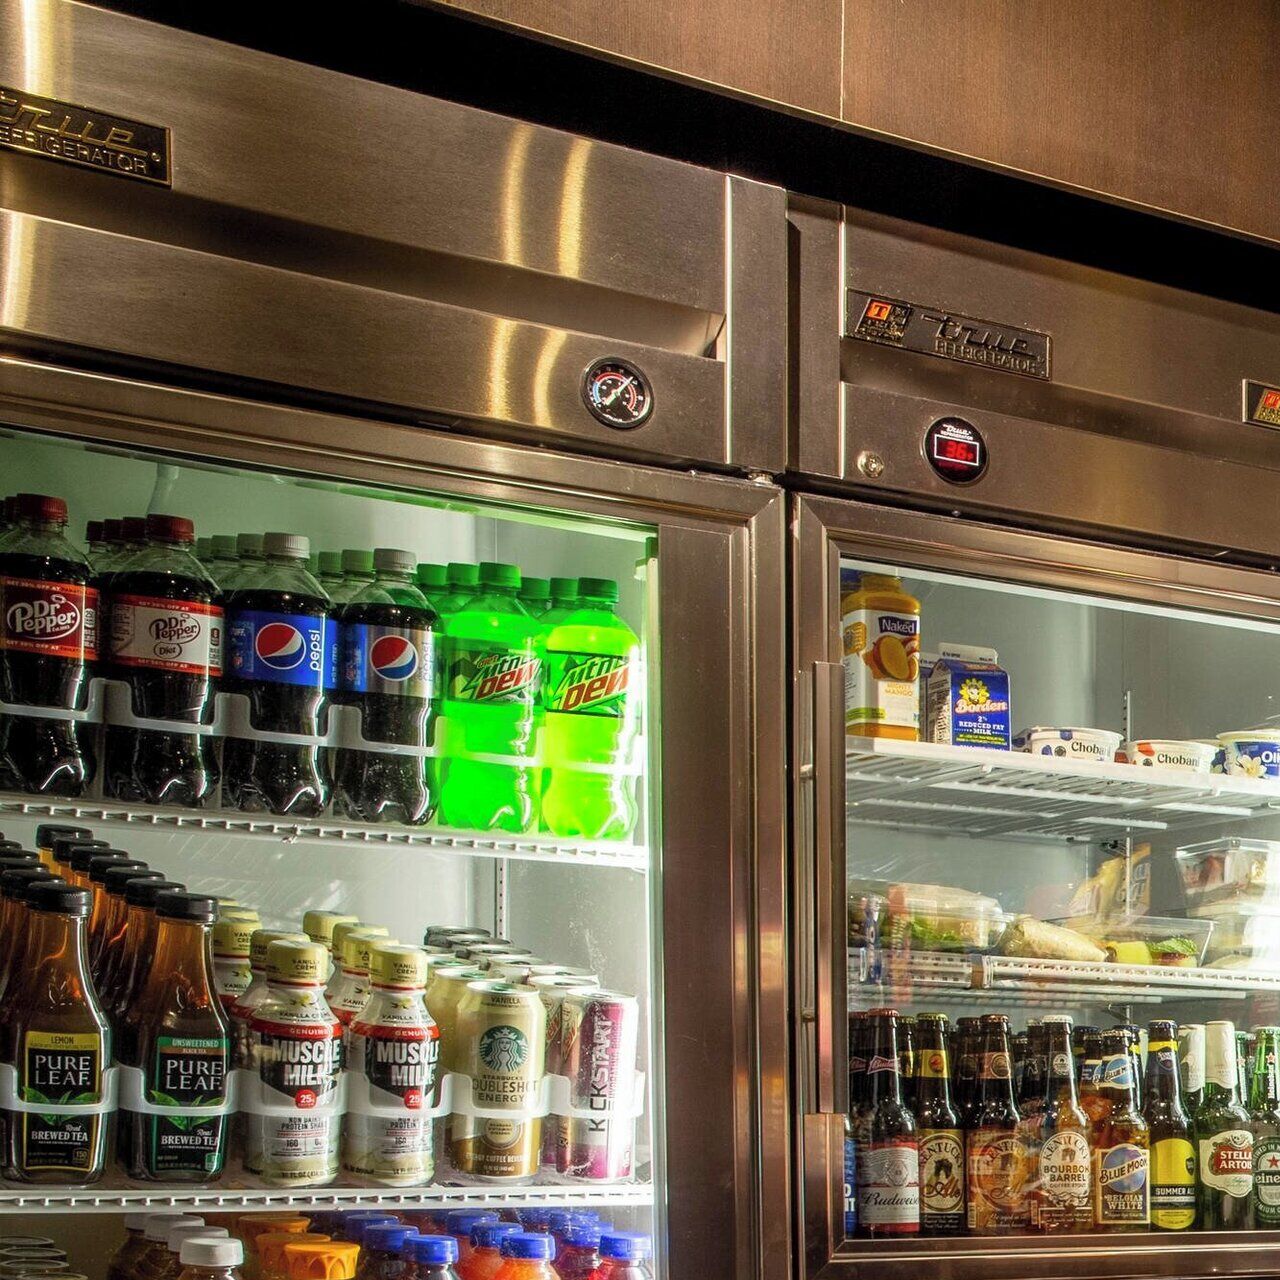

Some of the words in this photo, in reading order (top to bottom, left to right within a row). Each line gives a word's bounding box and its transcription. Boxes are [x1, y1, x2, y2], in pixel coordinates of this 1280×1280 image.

[33, 600, 61, 619] Dr
[15, 602, 76, 635] Pepper
[168, 616, 187, 630] Dr
[151, 619, 197, 641] Pepper
[882, 619, 915, 634] Naked
[159, 646, 176, 656] Diet
[308, 628, 323, 672] pepsi
[955, 699, 1008, 714] Borden
[959, 720, 991, 729] REDUCED
[993, 722, 1005, 731] FAT
[973, 728, 993, 736] MILK
[51, 1036, 74, 1046] LEMON
[172, 1038, 219, 1048] UNSWEETENED
[35, 1055, 91, 1071] PURE
[167, 1059, 223, 1076] PURE
[477, 1092, 524, 1103] ENERGY
[31, 1130, 70, 1141] BREWED
[72, 1131, 88, 1142] TEA
[161, 1135, 200, 1146] BREWED
[202, 1136, 219, 1147] TEA
[1043, 1164, 1089, 1174] BOURBON
[1049, 1173, 1086, 1183] BARREL
[1108, 1200, 1144, 1211] WHITE
